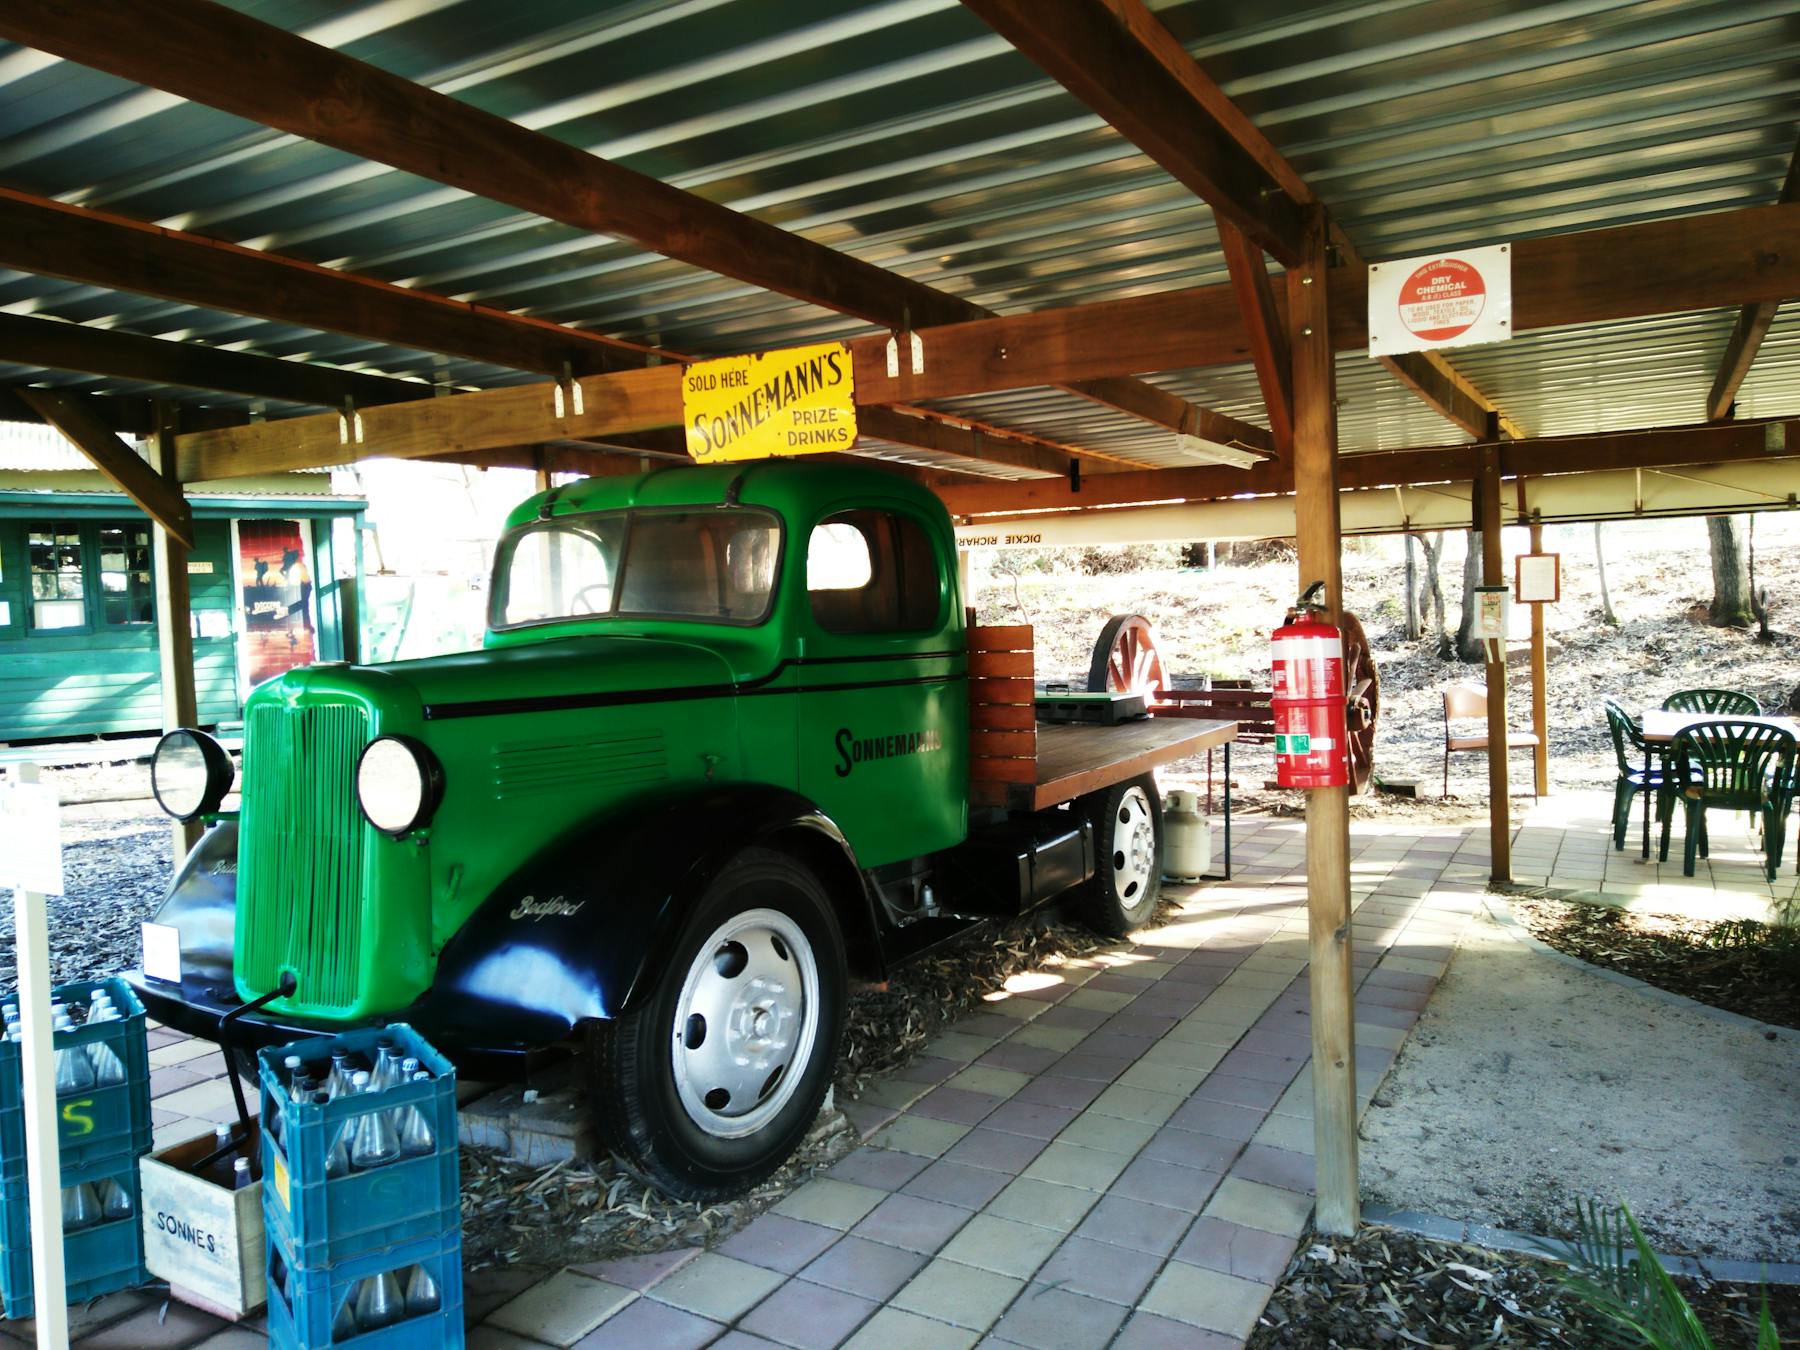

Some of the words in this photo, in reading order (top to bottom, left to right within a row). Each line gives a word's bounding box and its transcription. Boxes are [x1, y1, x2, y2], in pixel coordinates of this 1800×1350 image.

[1416, 281, 1467, 294] CHEMICAL
[1431, 275, 1452, 285] DRY
[1443, 290, 1462, 299] CLASS
[1441, 310, 1475, 320] ELECTRICAL
[688, 375, 717, 393] SOLD
[721, 369, 749, 388] HERE
[693, 350, 843, 457] SONNEMANN'S
[793, 408, 838, 426] PRIZE
[787, 427, 848, 447] DRINKS
[958, 536, 998, 546] RICHAR
[1005, 534, 1041, 544] DICKIE
[834, 728, 942, 778] SONNEMANNS
[510, 895, 586, 922] Bedford
[62, 1099, 94, 1137] S
[157, 1211, 215, 1253] SONNES
